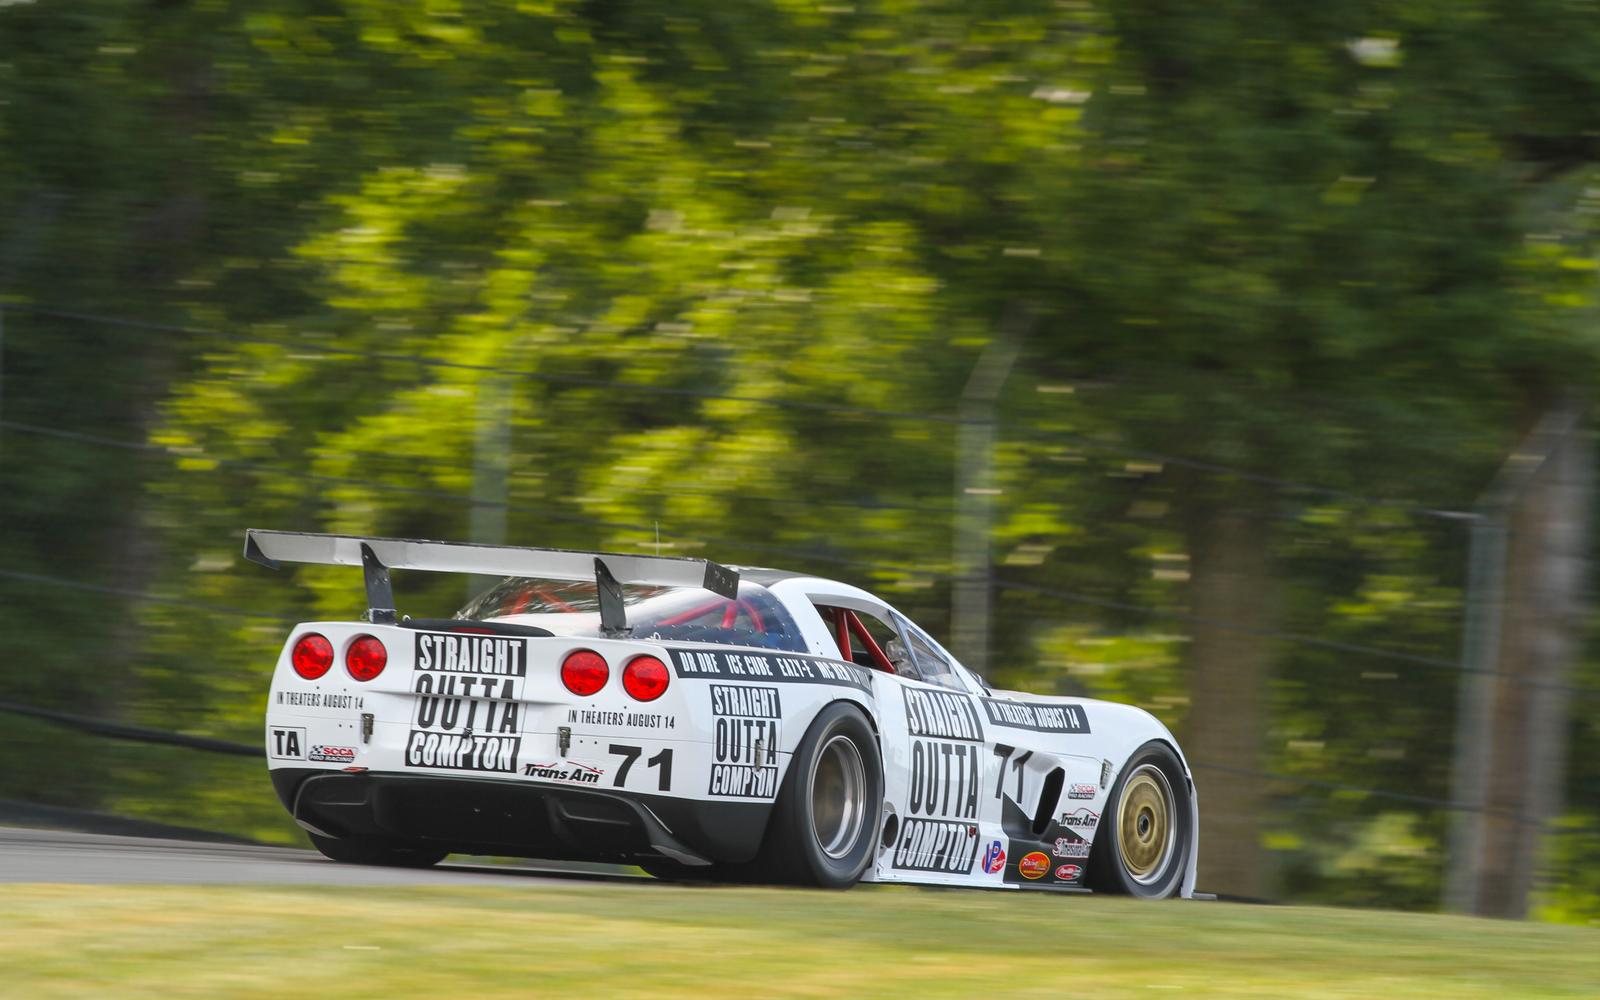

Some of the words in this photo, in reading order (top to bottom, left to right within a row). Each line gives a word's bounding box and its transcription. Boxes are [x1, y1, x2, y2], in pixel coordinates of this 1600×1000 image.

[419, 634, 522, 675] STRAIGHT
[679, 652, 697, 673] DR
[695, 653, 720, 673] DRE
[725, 654, 746, 675] ICE
[744, 656, 773, 676] CUBE
[776, 658, 815, 678] EAZY-E
[276, 691, 284, 705] IN
[286, 692, 321, 707] THEATERS
[323, 694, 353, 709] AUGUST
[354, 697, 364, 710] 14
[416, 673, 519, 734] OUTTA
[713, 686, 777, 718] STRAIGHT
[904, 687, 980, 740] STRAIGHT
[987, 701, 1003, 722] IN
[996, 702, 1037, 727] THEATERS
[1033, 706, 1068, 729] AUGUST
[1065, 707, 1080, 729] 14
[567, 709, 577, 723] IN
[581, 710, 624, 726] THEATERS
[626, 713, 661, 729] AUGUST
[664, 716, 675, 729] 14
[273, 729, 301, 757] TA
[323, 747, 354, 756] SCCA
[409, 732, 516, 771] COMPTON
[716, 717, 777, 765] OUTTA
[524, 763, 569, 780] Trans
[569, 768, 600, 783] Am
[608, 743, 674, 792] 71
[909, 740, 979, 819] OUTTA
[993, 742, 1034, 804] 71
[1060, 812, 1083, 826] Trans
[1081, 814, 1098, 827] Am
[896, 819, 977, 872] COMPTON
